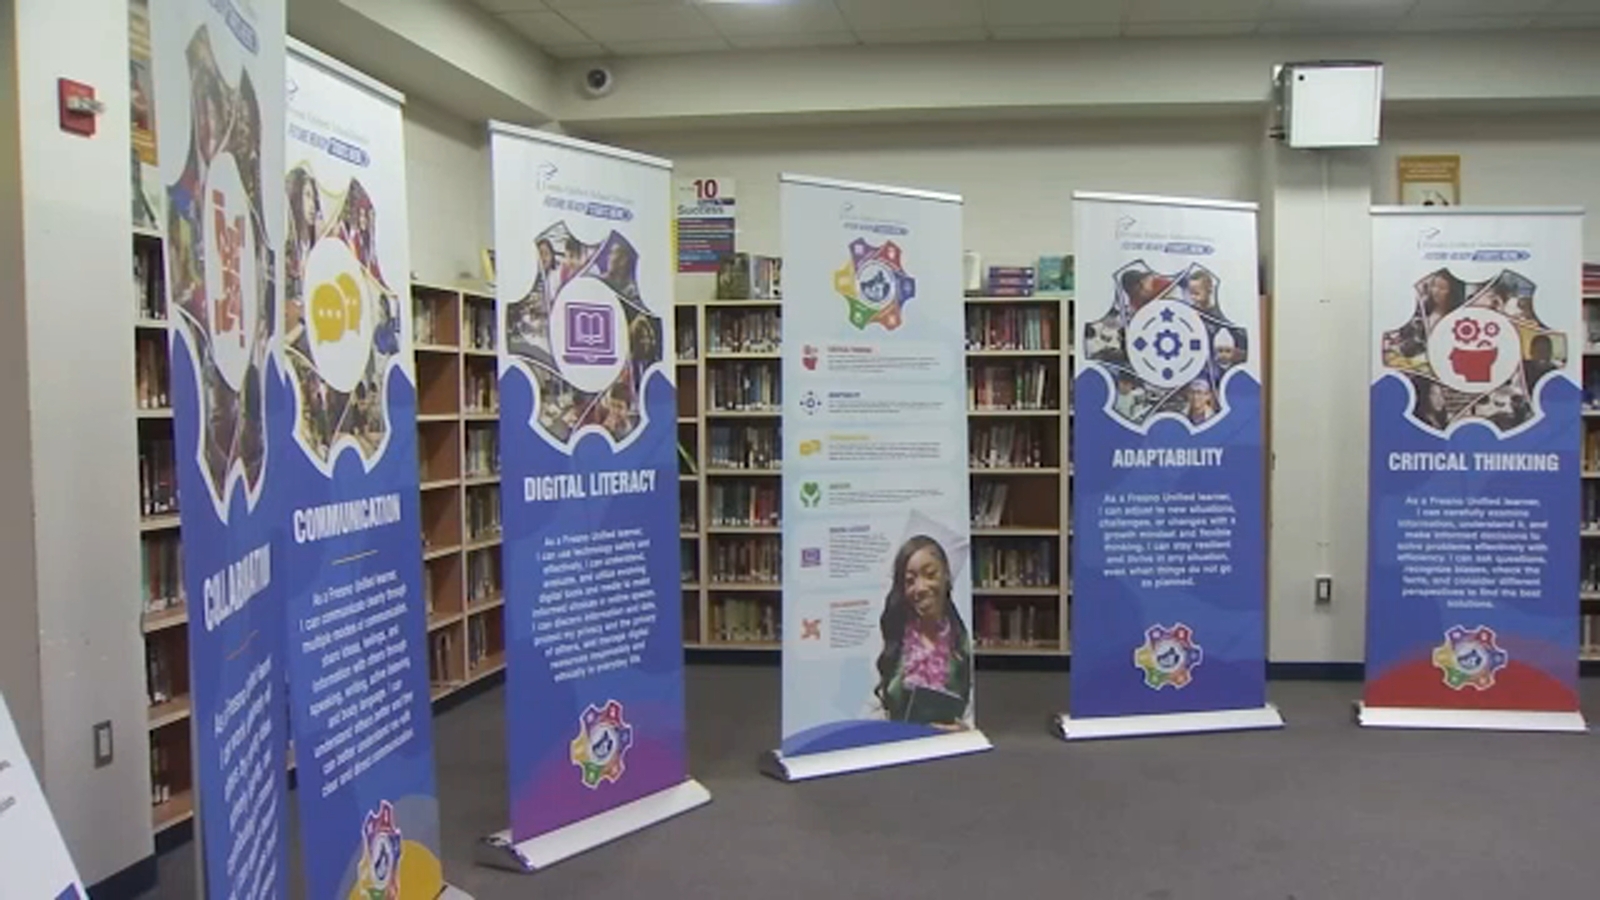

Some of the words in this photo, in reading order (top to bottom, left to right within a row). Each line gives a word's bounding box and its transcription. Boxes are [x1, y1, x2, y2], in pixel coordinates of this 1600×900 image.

[693, 179, 718, 199] 10
[677, 204, 724, 216] Success
[1111, 447, 1224, 468] ADAPTABILITY
[1388, 452, 1469, 472] CRITICAL
[1473, 452, 1560, 472] THINKING
[523, 474, 587, 502] DIGITAL
[589, 469, 657, 497] LITERACY
[293, 492, 401, 544] COMMUNICATION
